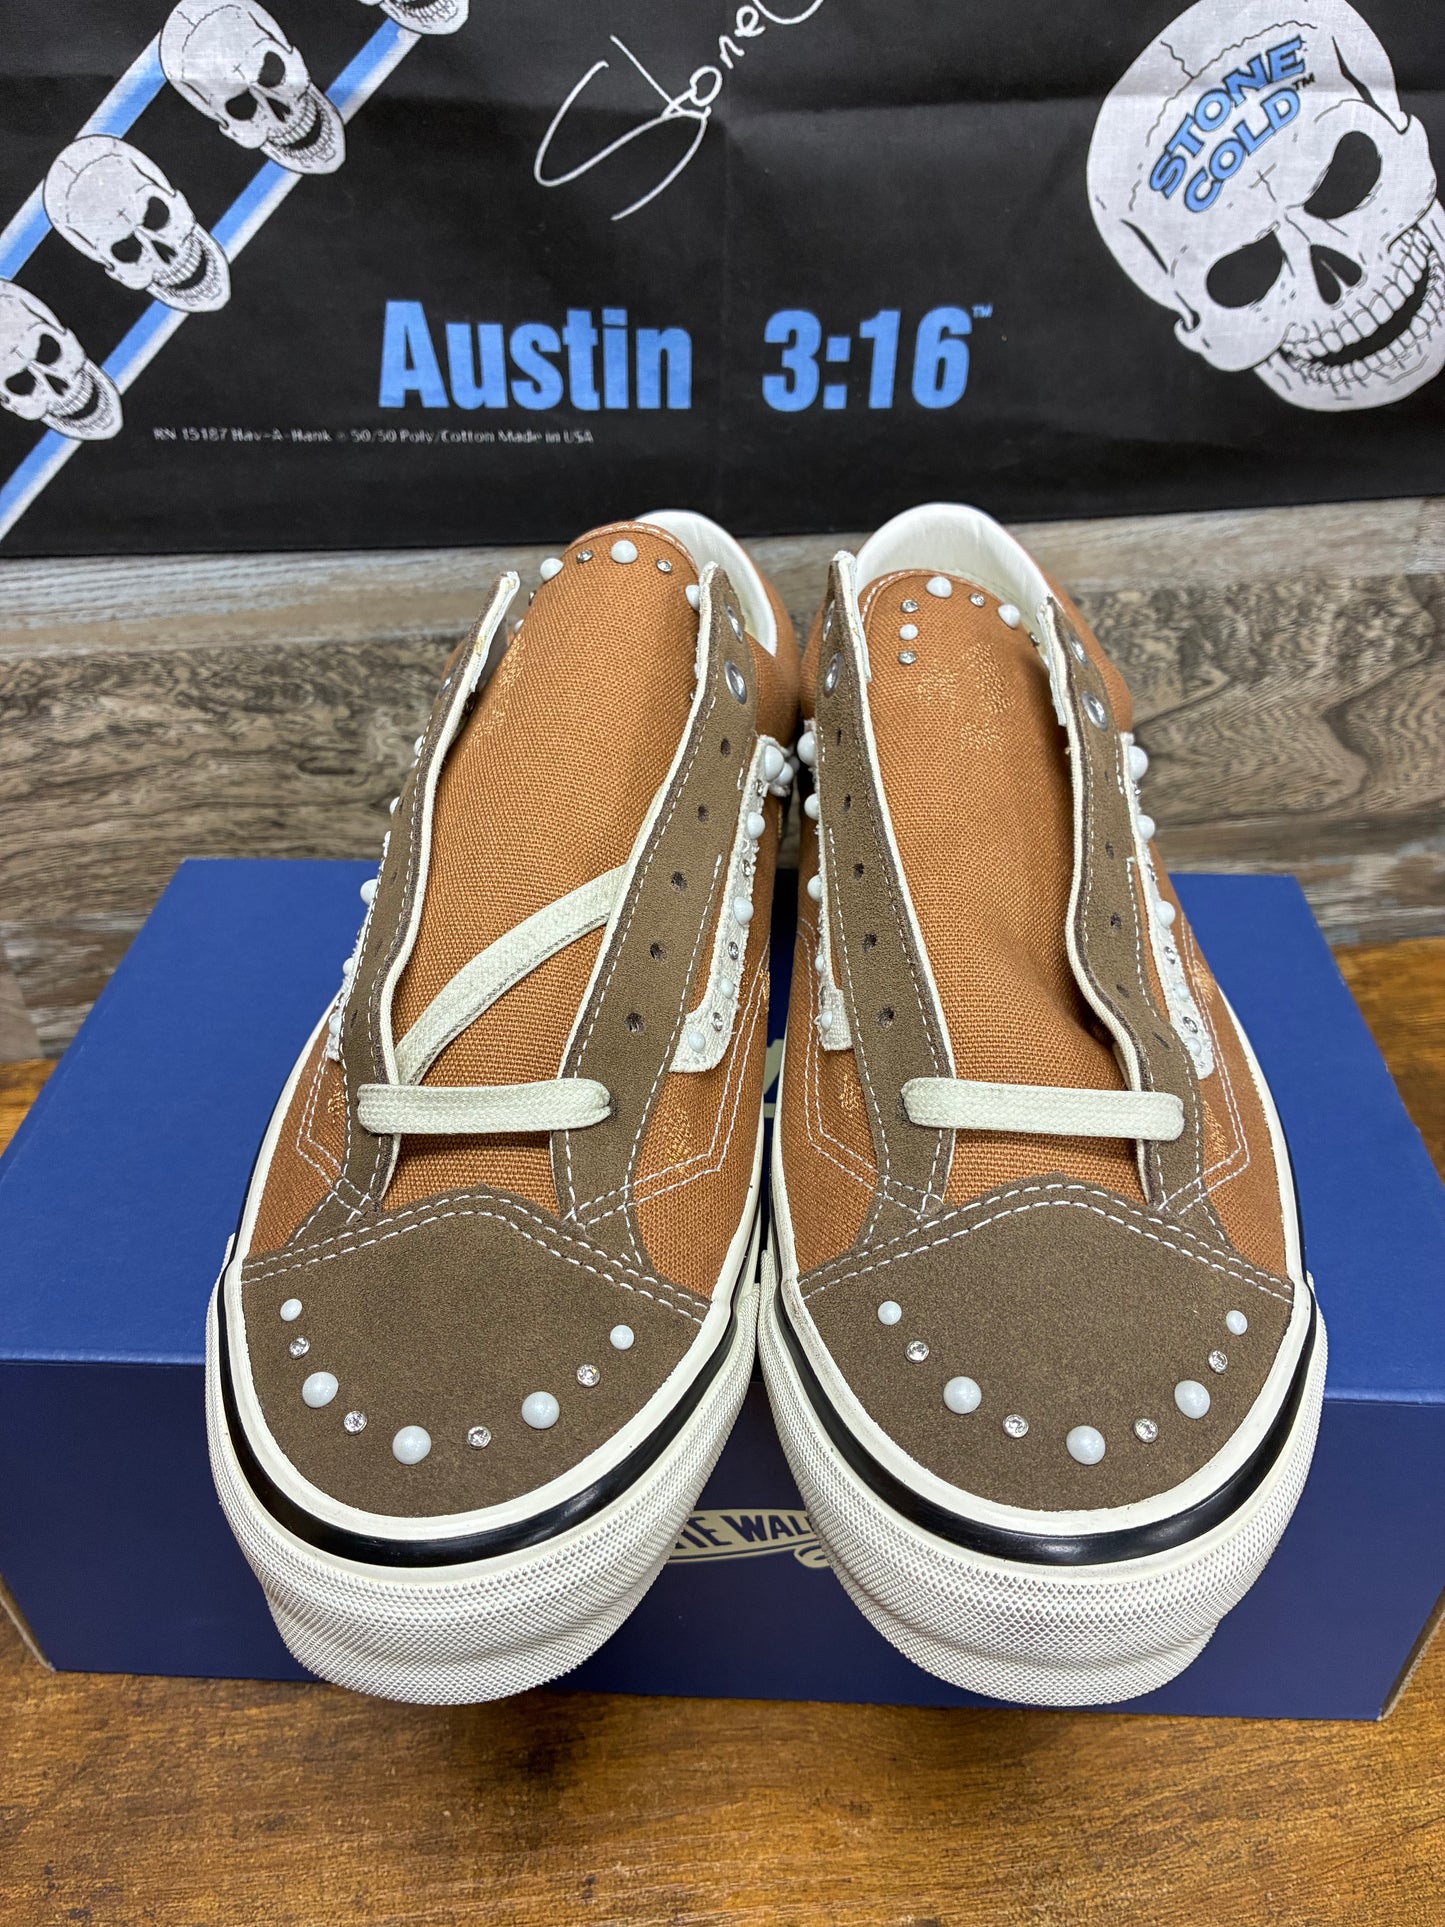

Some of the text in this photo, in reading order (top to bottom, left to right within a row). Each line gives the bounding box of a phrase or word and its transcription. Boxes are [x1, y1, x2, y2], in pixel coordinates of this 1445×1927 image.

[1149, 35, 1306, 199] STONE
[1184, 87, 1301, 213] COLD
[378, 300, 692, 410] Austin
[152, 426, 177, 441] RN
[498, 428, 542, 443] Made
[545, 429, 561, 443] in
[563, 429, 594, 443] USA
